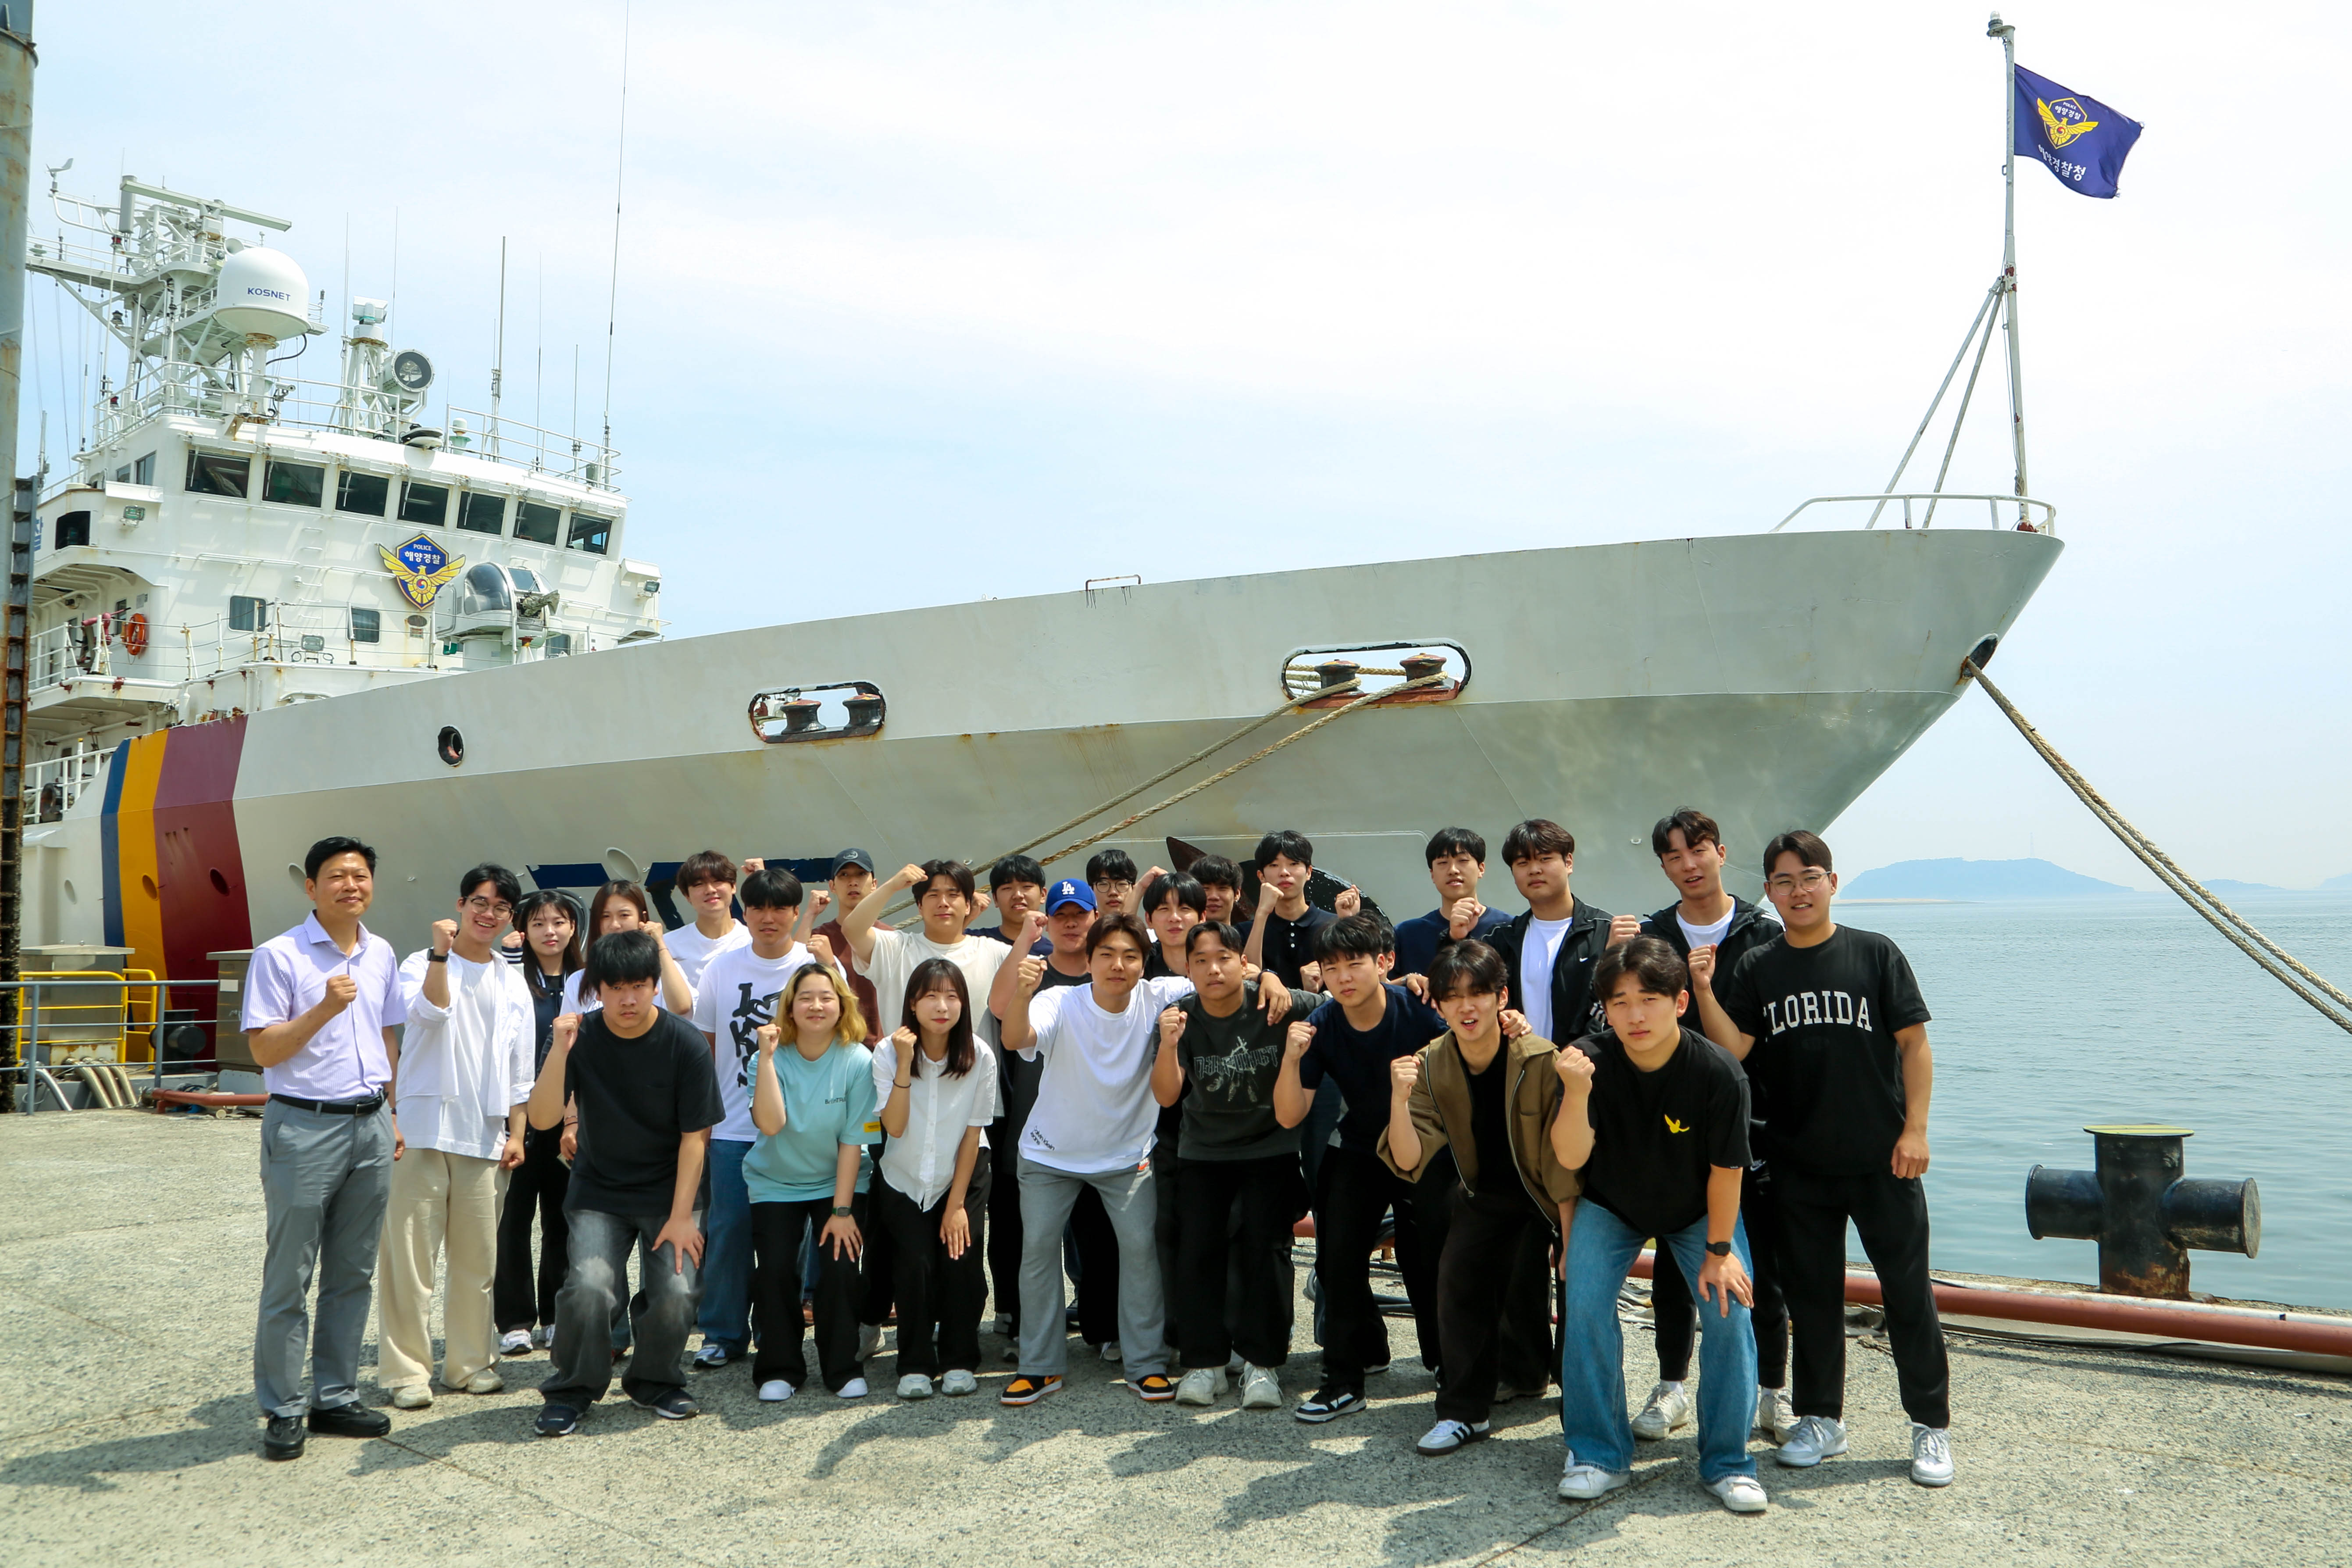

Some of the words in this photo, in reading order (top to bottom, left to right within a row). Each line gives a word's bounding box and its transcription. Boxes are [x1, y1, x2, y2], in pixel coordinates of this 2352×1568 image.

[2055, 105, 2081, 120] 해양경찰
[2063, 102, 2077, 110] POLICE
[2038, 144, 2086, 181] 해양경찰청
[247, 287, 291, 301] KOSNET
[404, 551, 441, 565] 해양경찰
[1062, 881, 1074, 895] LA
[1763, 990, 1872, 1042] LORIDA
